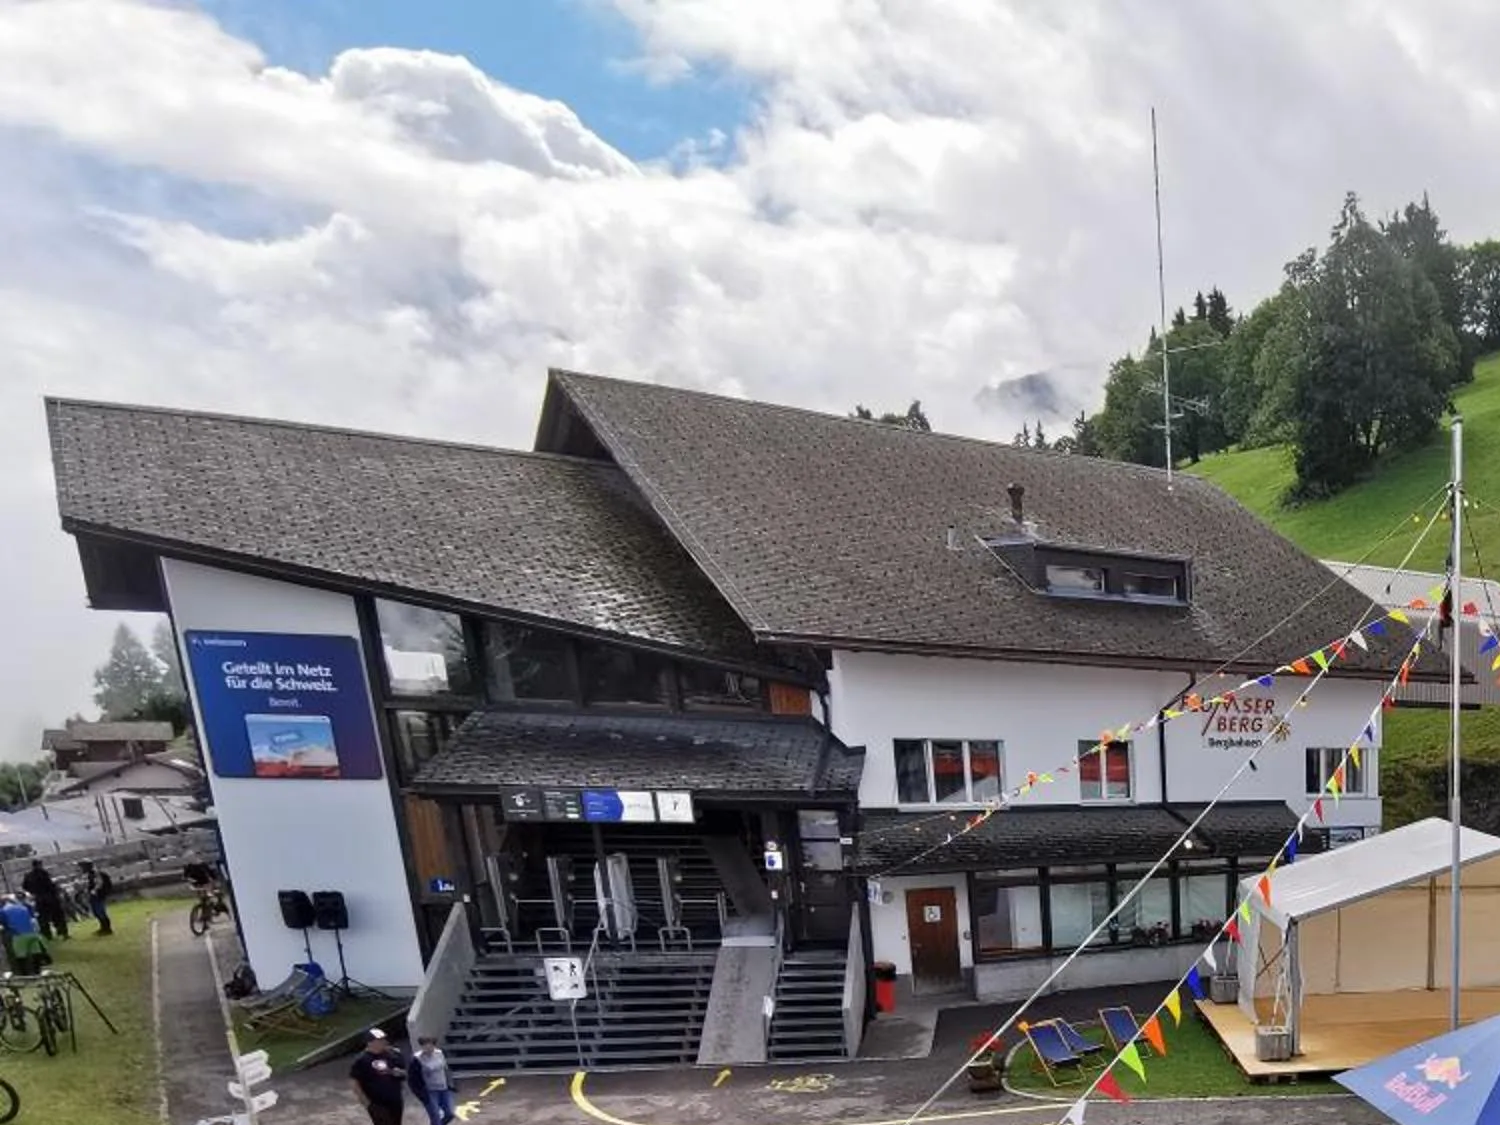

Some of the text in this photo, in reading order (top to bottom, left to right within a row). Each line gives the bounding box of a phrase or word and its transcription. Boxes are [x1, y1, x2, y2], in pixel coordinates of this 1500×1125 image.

[221, 661, 333, 677] Geteilt im Netz
[225, 675, 247, 689] für
[250, 677, 273, 690] die
[1217, 717, 1263, 733] BERG
